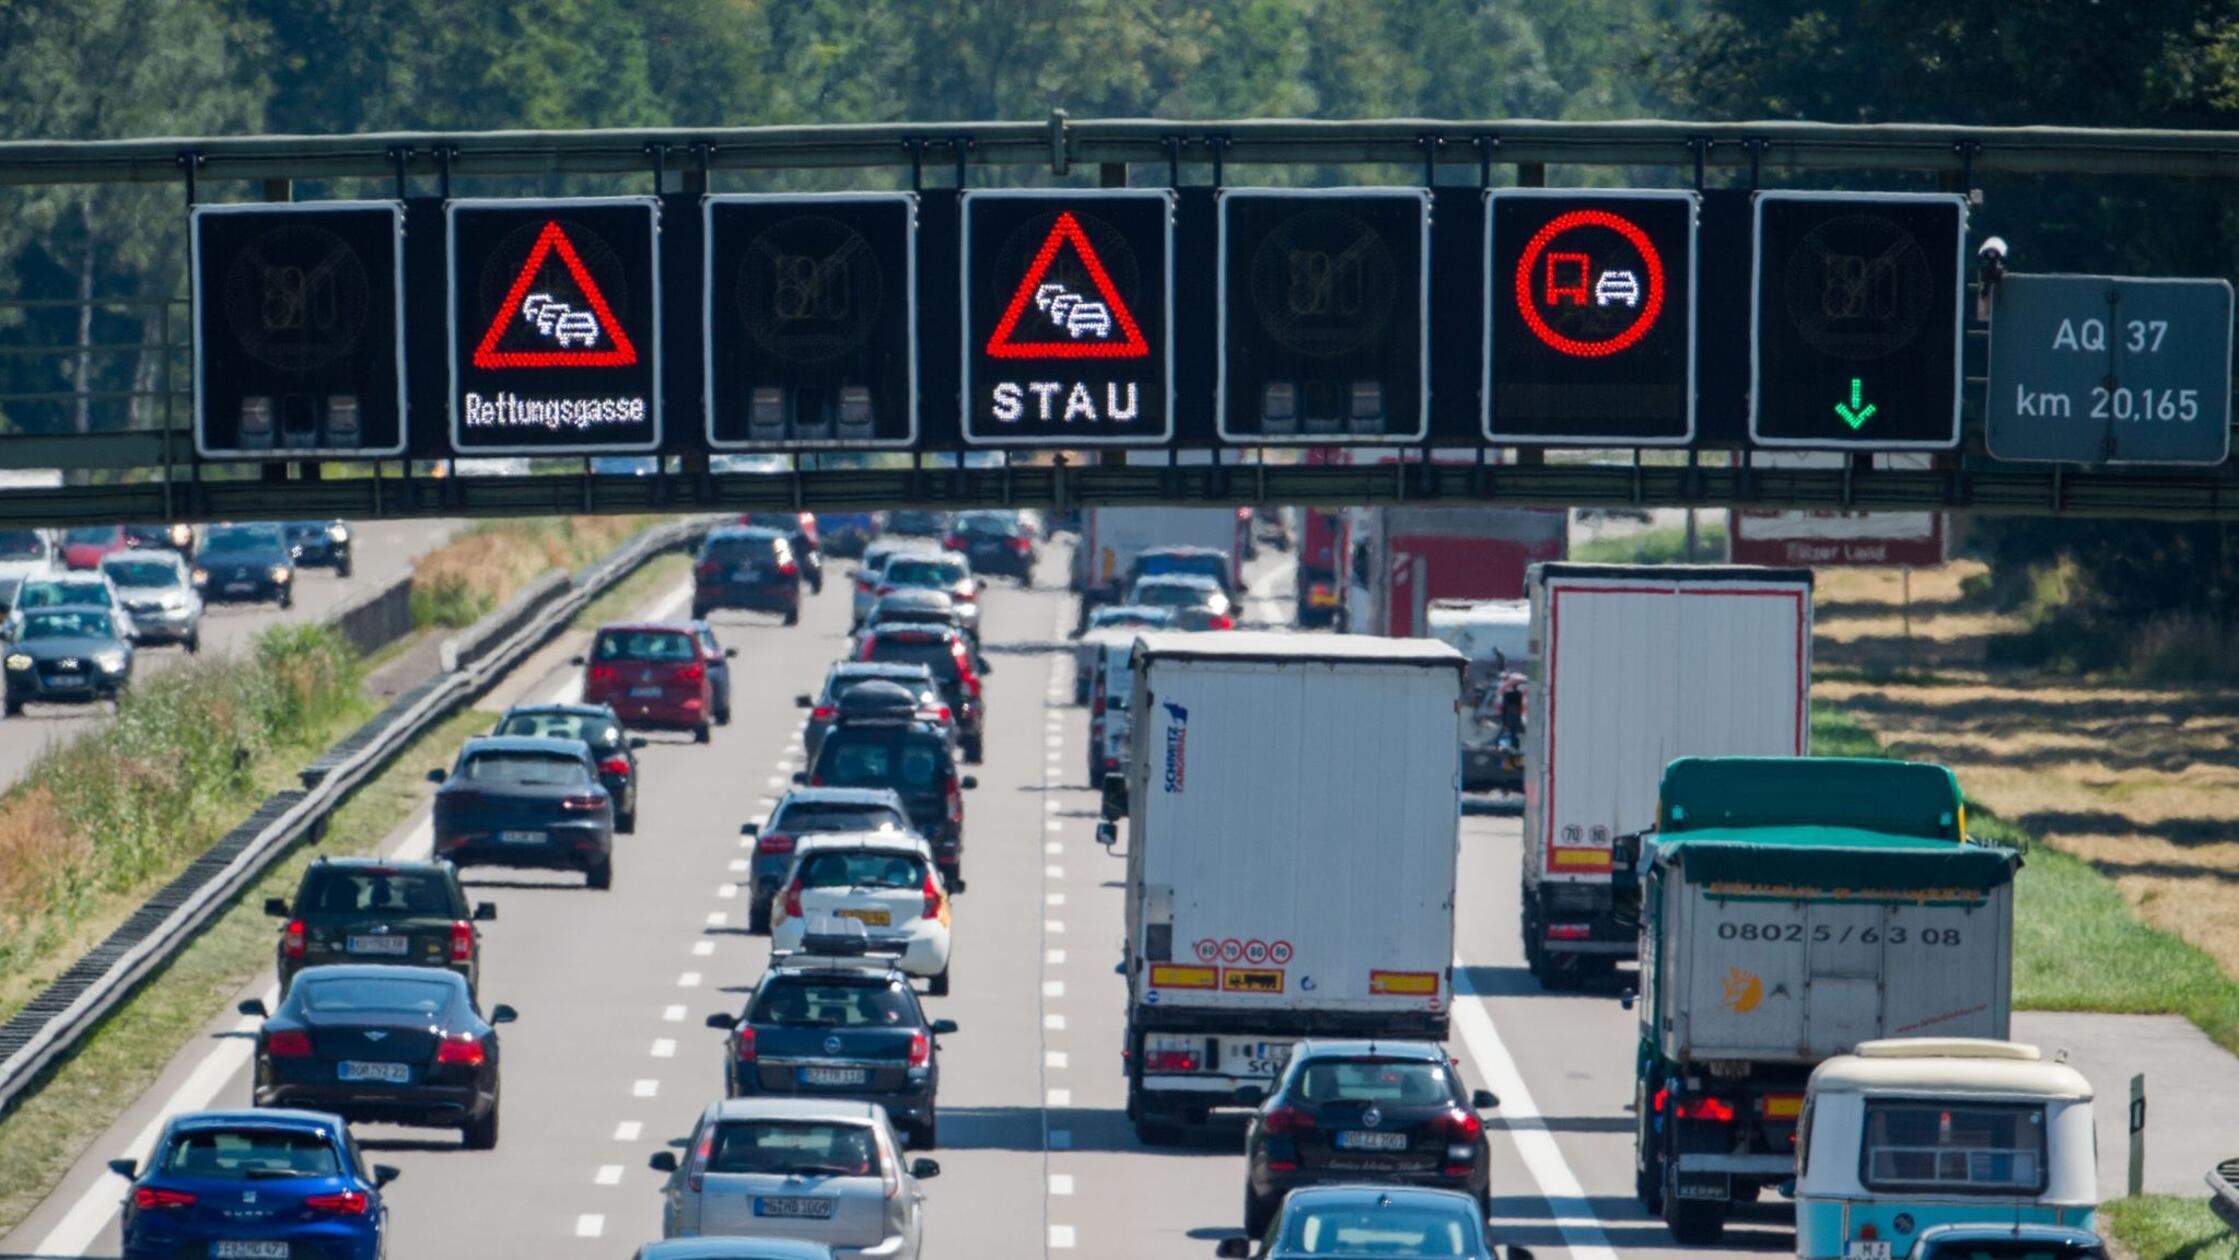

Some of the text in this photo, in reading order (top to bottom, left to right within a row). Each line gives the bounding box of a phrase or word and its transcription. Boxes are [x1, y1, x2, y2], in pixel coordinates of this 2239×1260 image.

[2052, 318, 2168, 352] AQ 37
[465, 391, 645, 431] Rettungsgasse
[992, 381, 1138, 422] STAU
[2016, 383, 2199, 421] km 20,165
[1164, 726, 1178, 793] SCHMITZ
